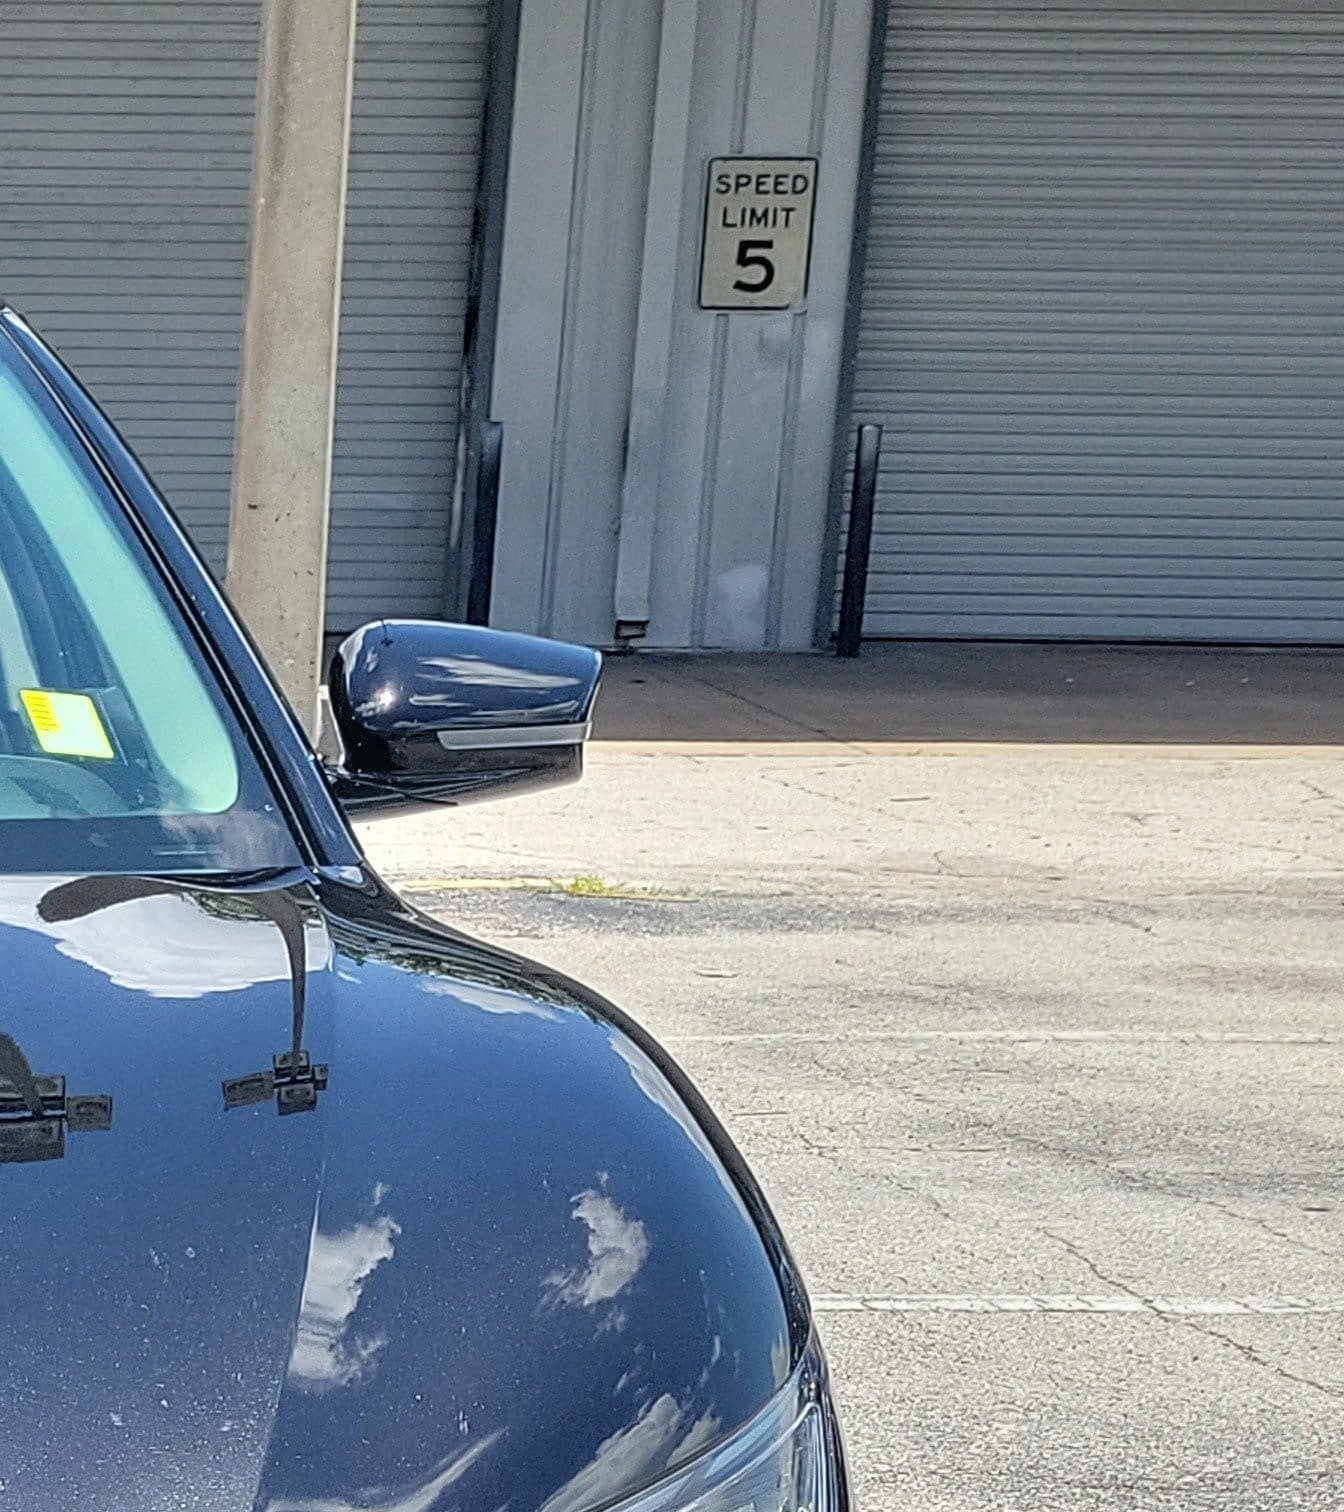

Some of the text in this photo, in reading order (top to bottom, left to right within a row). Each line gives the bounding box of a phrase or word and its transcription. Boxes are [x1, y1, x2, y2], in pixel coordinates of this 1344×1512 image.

[715, 174, 809, 195] SPEED
[721, 206, 796, 228] LIMIT
[732, 239, 775, 293] 5
